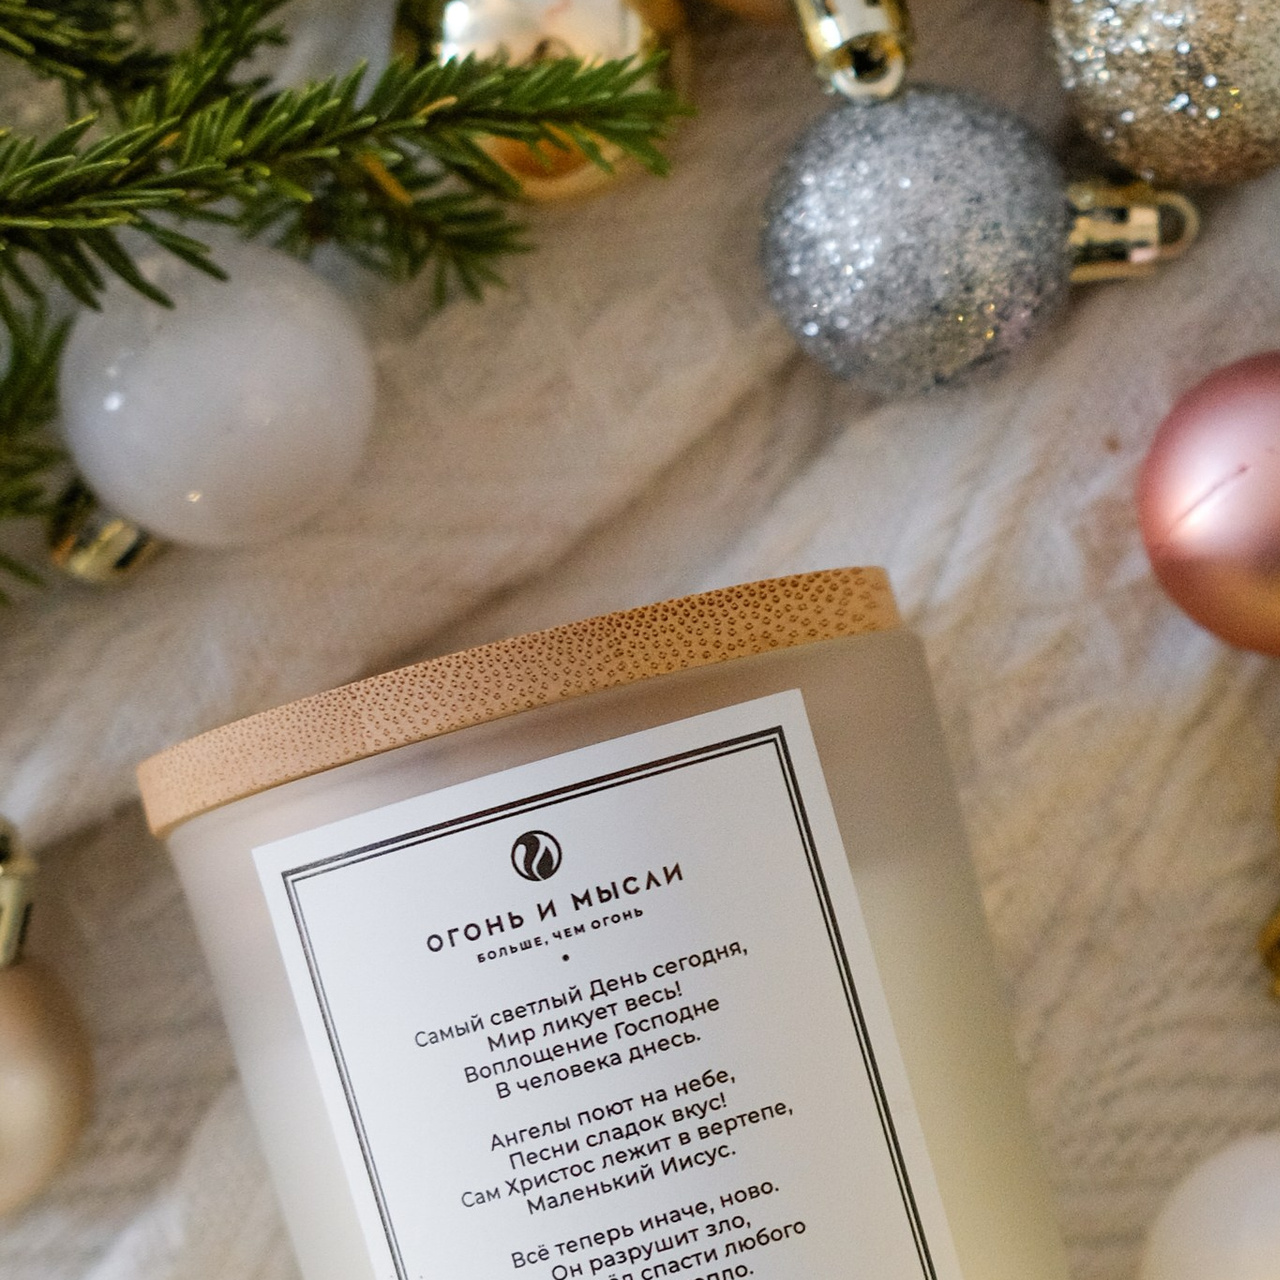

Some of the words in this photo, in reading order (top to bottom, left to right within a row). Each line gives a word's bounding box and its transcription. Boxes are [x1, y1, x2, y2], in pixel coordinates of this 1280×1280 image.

[425, 910, 524, 953] ОГОНЬ
[535, 898, 557, 922] И
[569, 861, 683, 911] МЫСЛИ
[476, 935, 549, 964] БОЛЬШЕ,
[551, 923, 586, 940] ЧЕМ
[589, 907, 643, 930] ОГОНЬ
[413, 1013, 485, 1047] Самый
[489, 984, 583, 1026] светлый
[588, 970, 648, 1001] День
[652, 940, 748, 978] сегодня,
[486, 1027, 536, 1052] Мир
[542, 1001, 618, 1037] ликует
[623, 979, 683, 1012] весь!
[463, 1030, 608, 1084] Воплощение
[613, 997, 720, 1040] Господне
[494, 1080, 512, 1099] В
[515, 1051, 623, 1092] человека
[628, 1031, 701, 1064] днесь.
[490, 1115, 571, 1152] Ангелы
[576, 1096, 634, 1126] поют
[639, 1087, 668, 1107] на
[673, 1068, 735, 1097] небе,
[508, 1138, 580, 1170] Песни
[585, 1112, 667, 1148] сладок
[670, 1090, 727, 1123] вкус!
[460, 1186, 501, 1208] Сам
[503, 1159, 596, 1197] Христос
[601, 1135, 671, 1169] лежит
[677, 1130, 692, 1146] в
[696, 1101, 793, 1140] вертепе,
[525, 1162, 655, 1215] Маленький
[659, 1143, 736, 1176] Иисус.
[510, 1243, 550, 1269] Всё
[553, 1224, 634, 1256] теперь
[638, 1200, 715, 1232] иначе,
[718, 1180, 779, 1208] ново.
[588, 1227, 699, 1276] разрушит
[704, 1214, 751, 1237] зло,
[640, 1247, 718, 1280] спасти
[724, 1220, 806, 1258] любого
